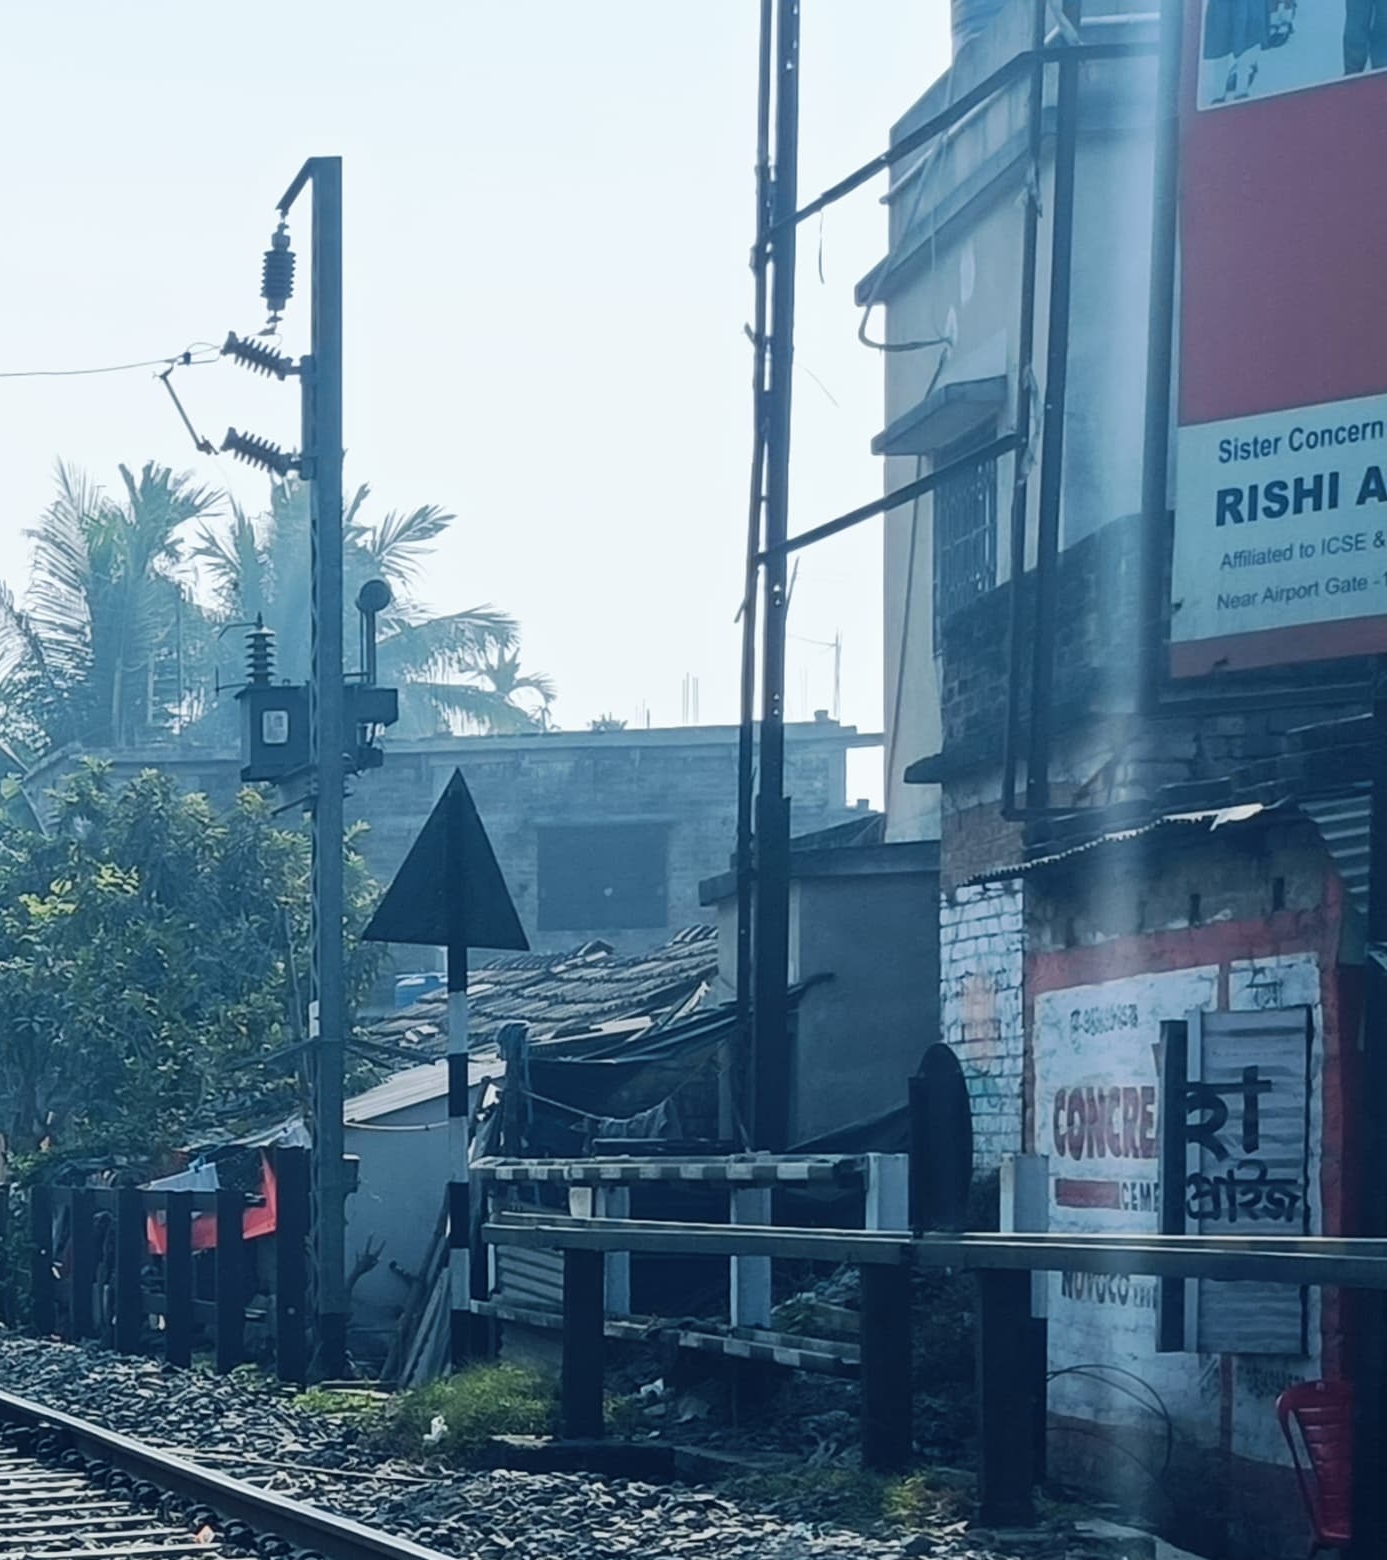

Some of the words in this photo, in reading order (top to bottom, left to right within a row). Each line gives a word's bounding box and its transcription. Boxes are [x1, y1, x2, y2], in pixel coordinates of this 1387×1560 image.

[1218, 436, 1282, 464] Sister
[1288, 420, 1384, 452] Concern
[1215, 471, 1340, 527] RISHI
[1355, 465, 1387, 506] A
[1219, 544, 1293, 571] Affiliated
[1299, 543, 1315, 559] to
[1321, 532, 1367, 556] ICSE
[1373, 530, 1386, 549] &
[1216, 593, 1258, 611] Near
[1262, 580, 1319, 605] Airport
[1325, 576, 1368, 595] Gate
